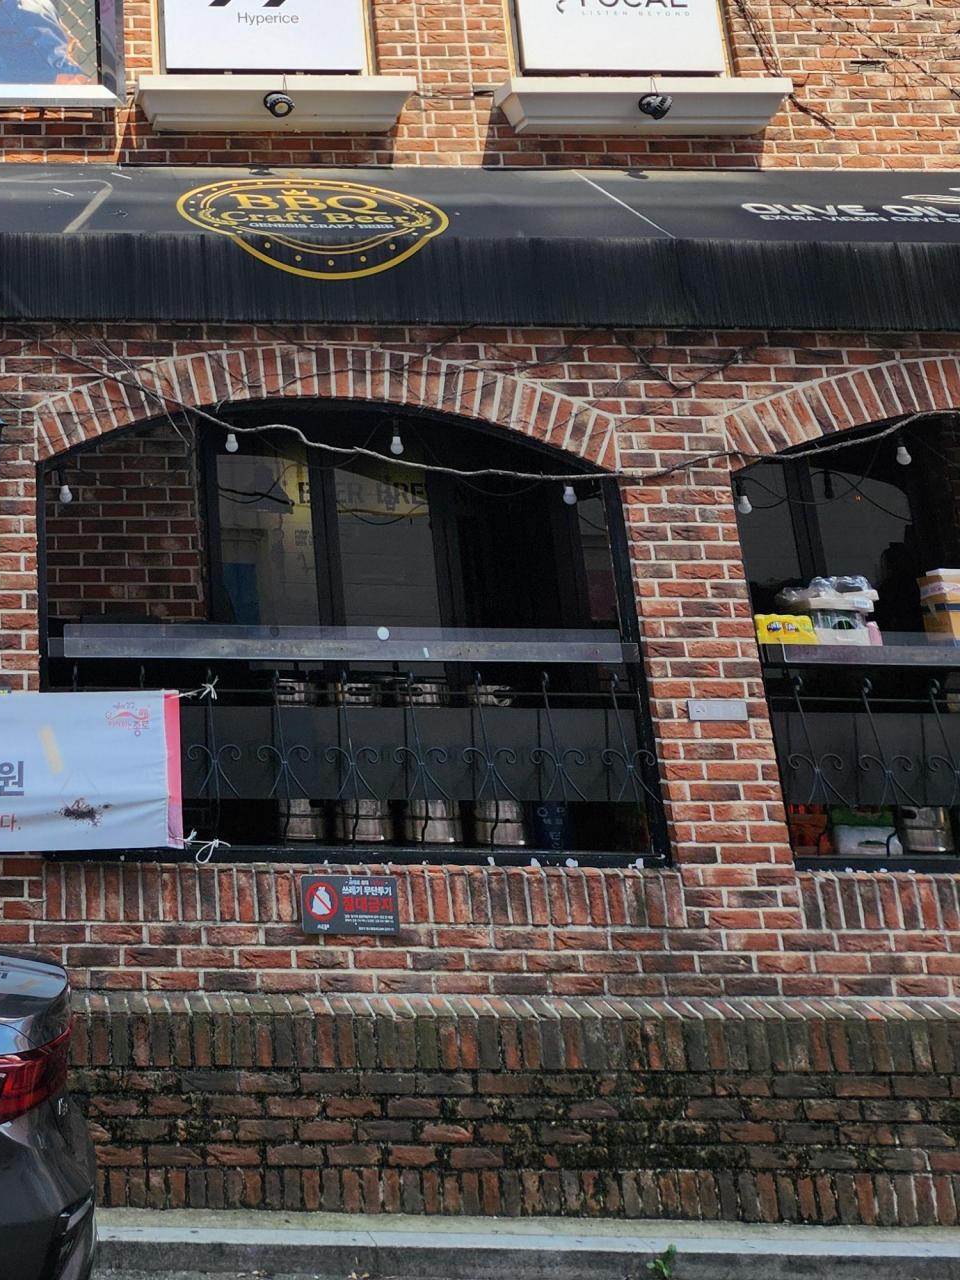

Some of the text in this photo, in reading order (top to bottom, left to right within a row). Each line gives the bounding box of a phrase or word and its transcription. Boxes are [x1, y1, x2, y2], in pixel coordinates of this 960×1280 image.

[237, 11, 300, 26] Hyperice
[230, 193, 387, 214] BBQ
[741, 202, 960, 217] OLIVE OIL
[220, 211, 410, 224] Craft Beer
